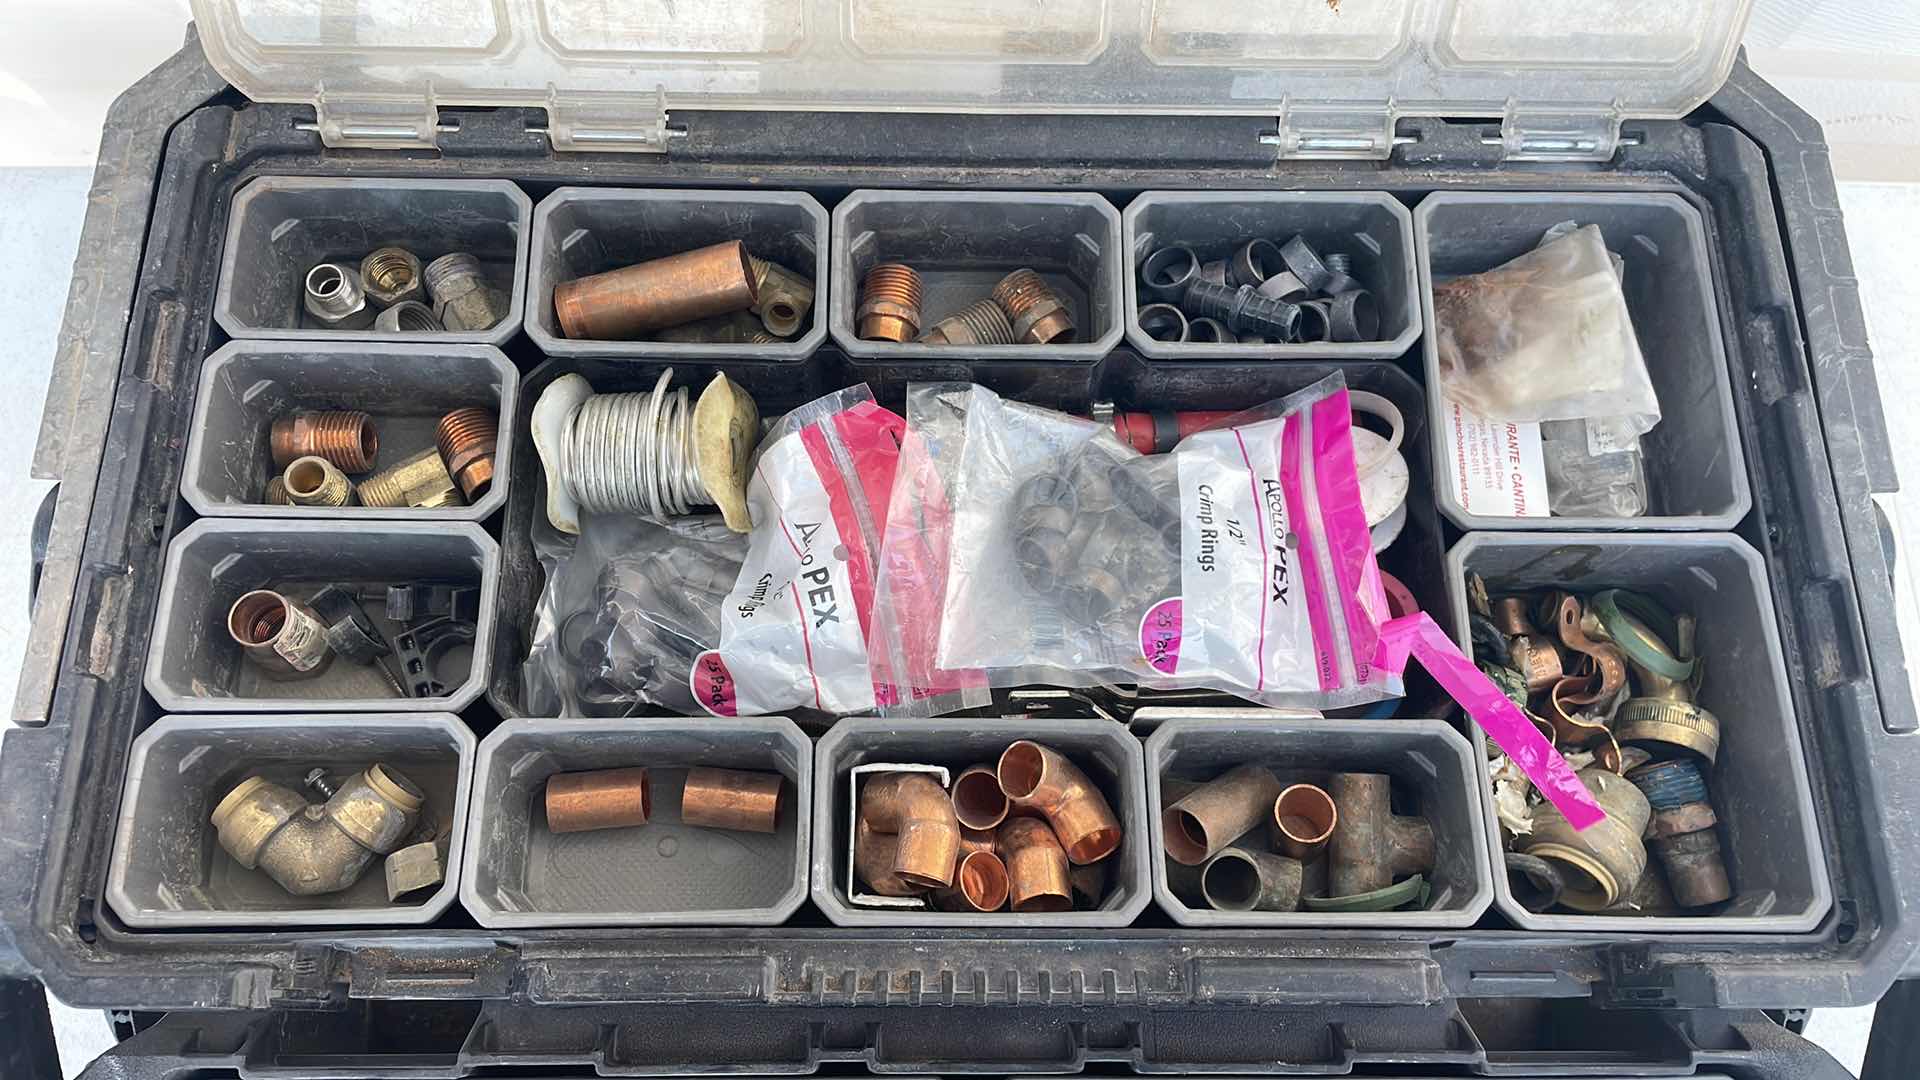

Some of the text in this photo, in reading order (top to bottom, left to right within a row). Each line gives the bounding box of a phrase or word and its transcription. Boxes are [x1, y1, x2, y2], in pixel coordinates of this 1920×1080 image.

[1196, 484, 1217, 572] Crimp Rings
[1226, 518, 1247, 546] 1/2"
[1262, 479, 1289, 607] APOLLO PEX
[802, 566, 840, 629] PEX
[1158, 611, 1173, 628] 25
[710, 675, 728, 706] Pack
